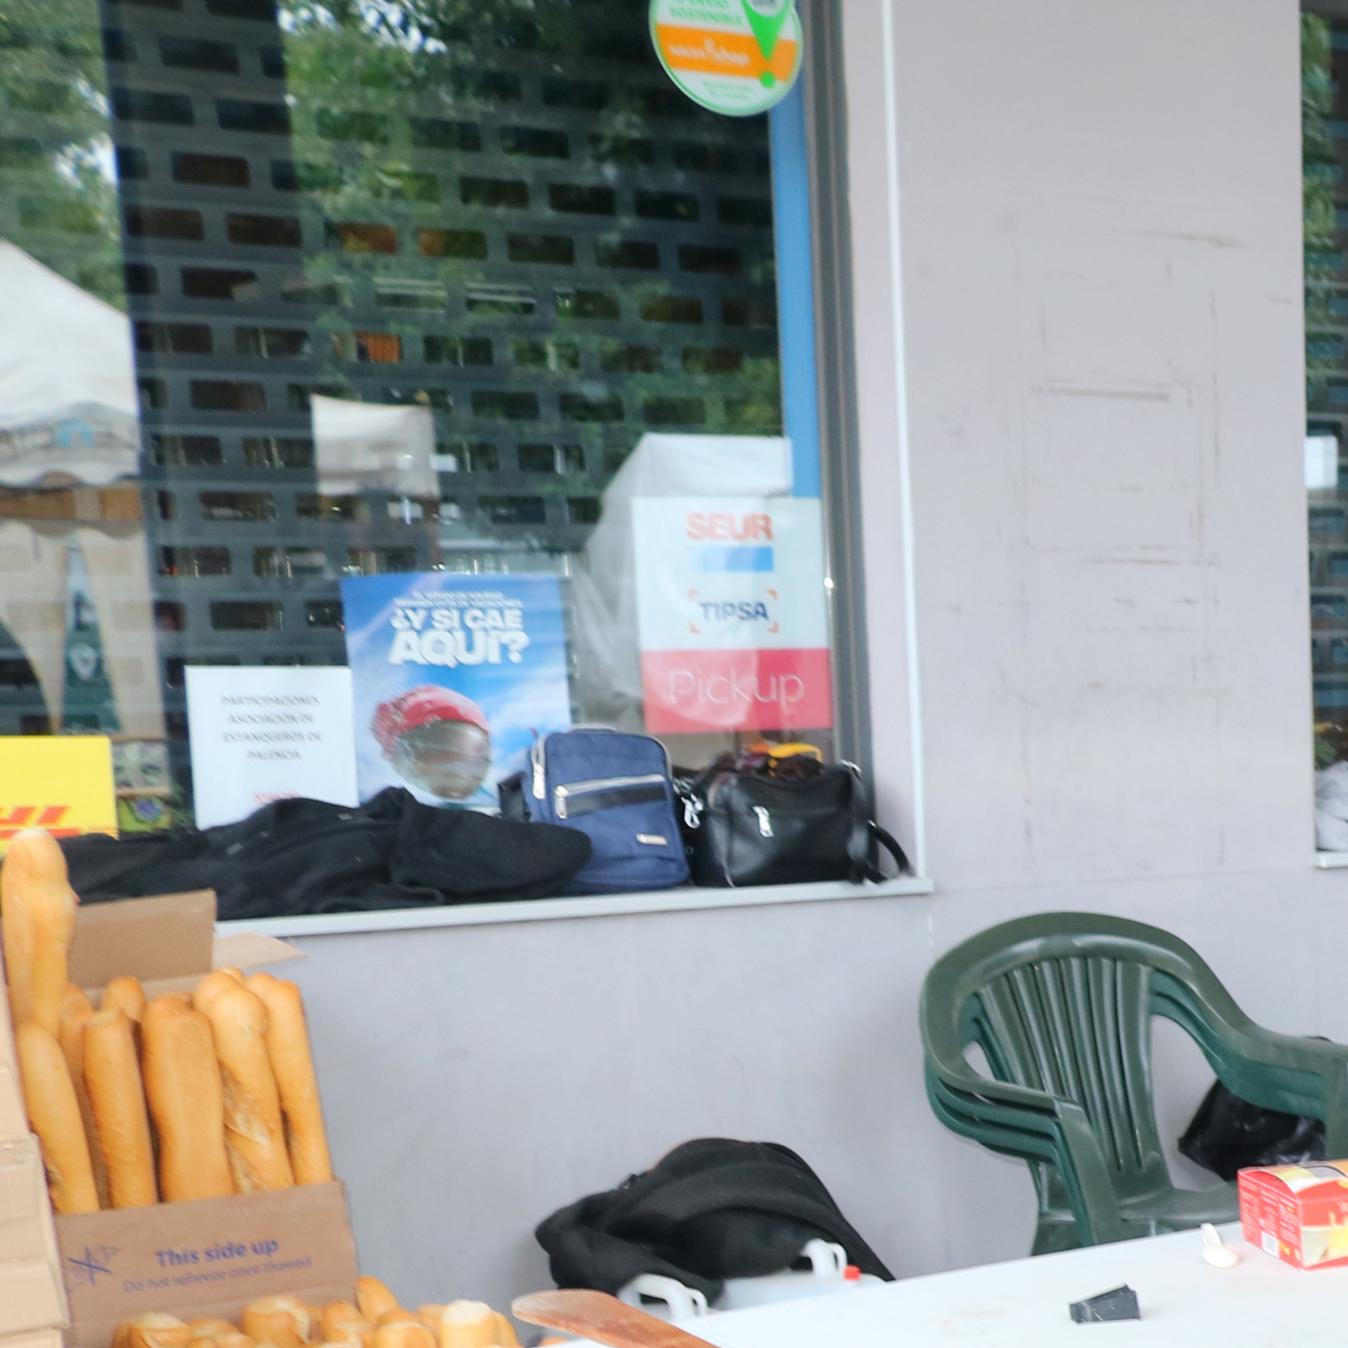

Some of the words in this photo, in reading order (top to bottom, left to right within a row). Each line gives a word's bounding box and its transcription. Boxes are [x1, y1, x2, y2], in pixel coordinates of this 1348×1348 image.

[686, 513, 773, 540] SEUR
[432, 608, 460, 629] SI
[464, 608, 523, 629] CAE
[698, 602, 770, 621] TIPSA
[668, 669, 805, 714] Pickup
[156, 1249, 199, 1268] This
[204, 1242, 247, 1261] side
[252, 1239, 279, 1258] up
